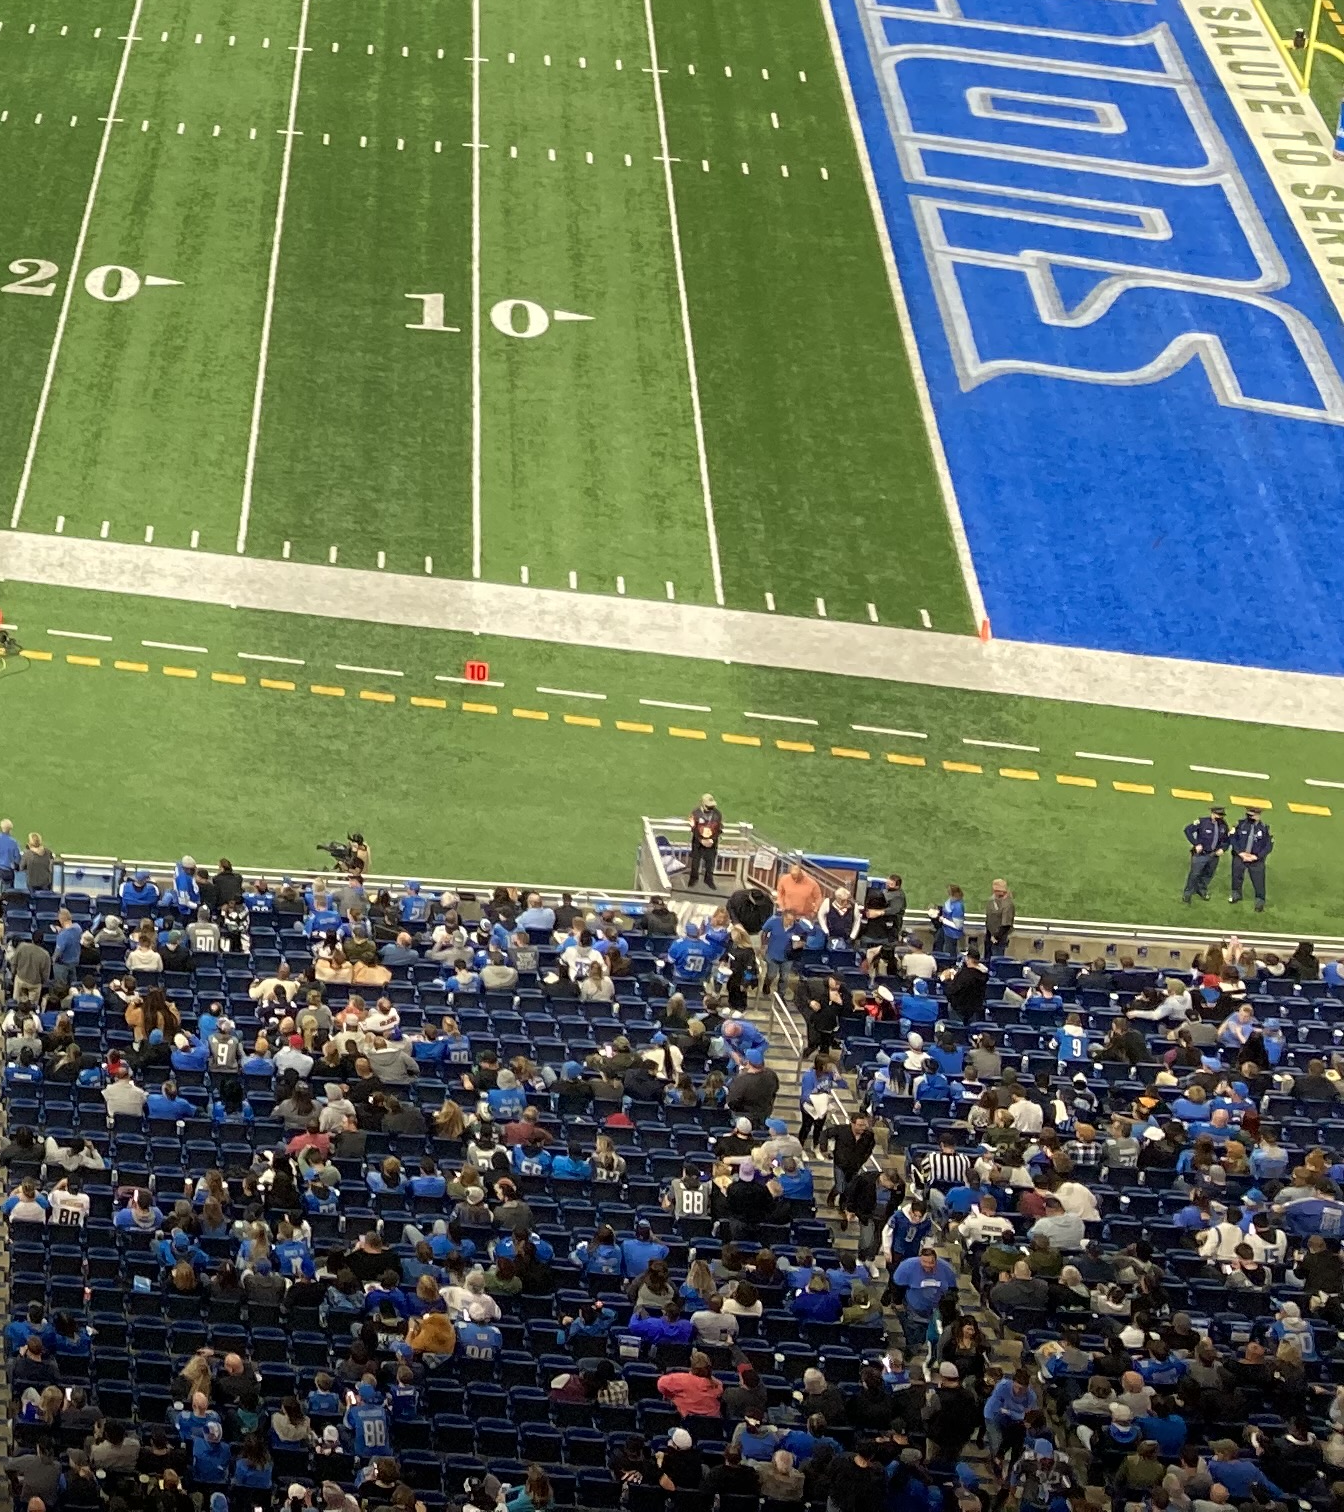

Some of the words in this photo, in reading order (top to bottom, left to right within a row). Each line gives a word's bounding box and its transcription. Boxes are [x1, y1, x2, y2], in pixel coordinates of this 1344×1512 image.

[1198, 6, 1307, 118] SALUTE
[1261, 130, 1334, 168] TO
[0, 256, 142, 302] 20
[402, 292, 550, 338] 10
[470, 663, 486, 681] 10
[216, 1042, 228, 1064] 9
[1072, 1038, 1082, 1056] 9
[682, 1190, 704, 1214] 88
[362, 1421, 386, 1446] 88
